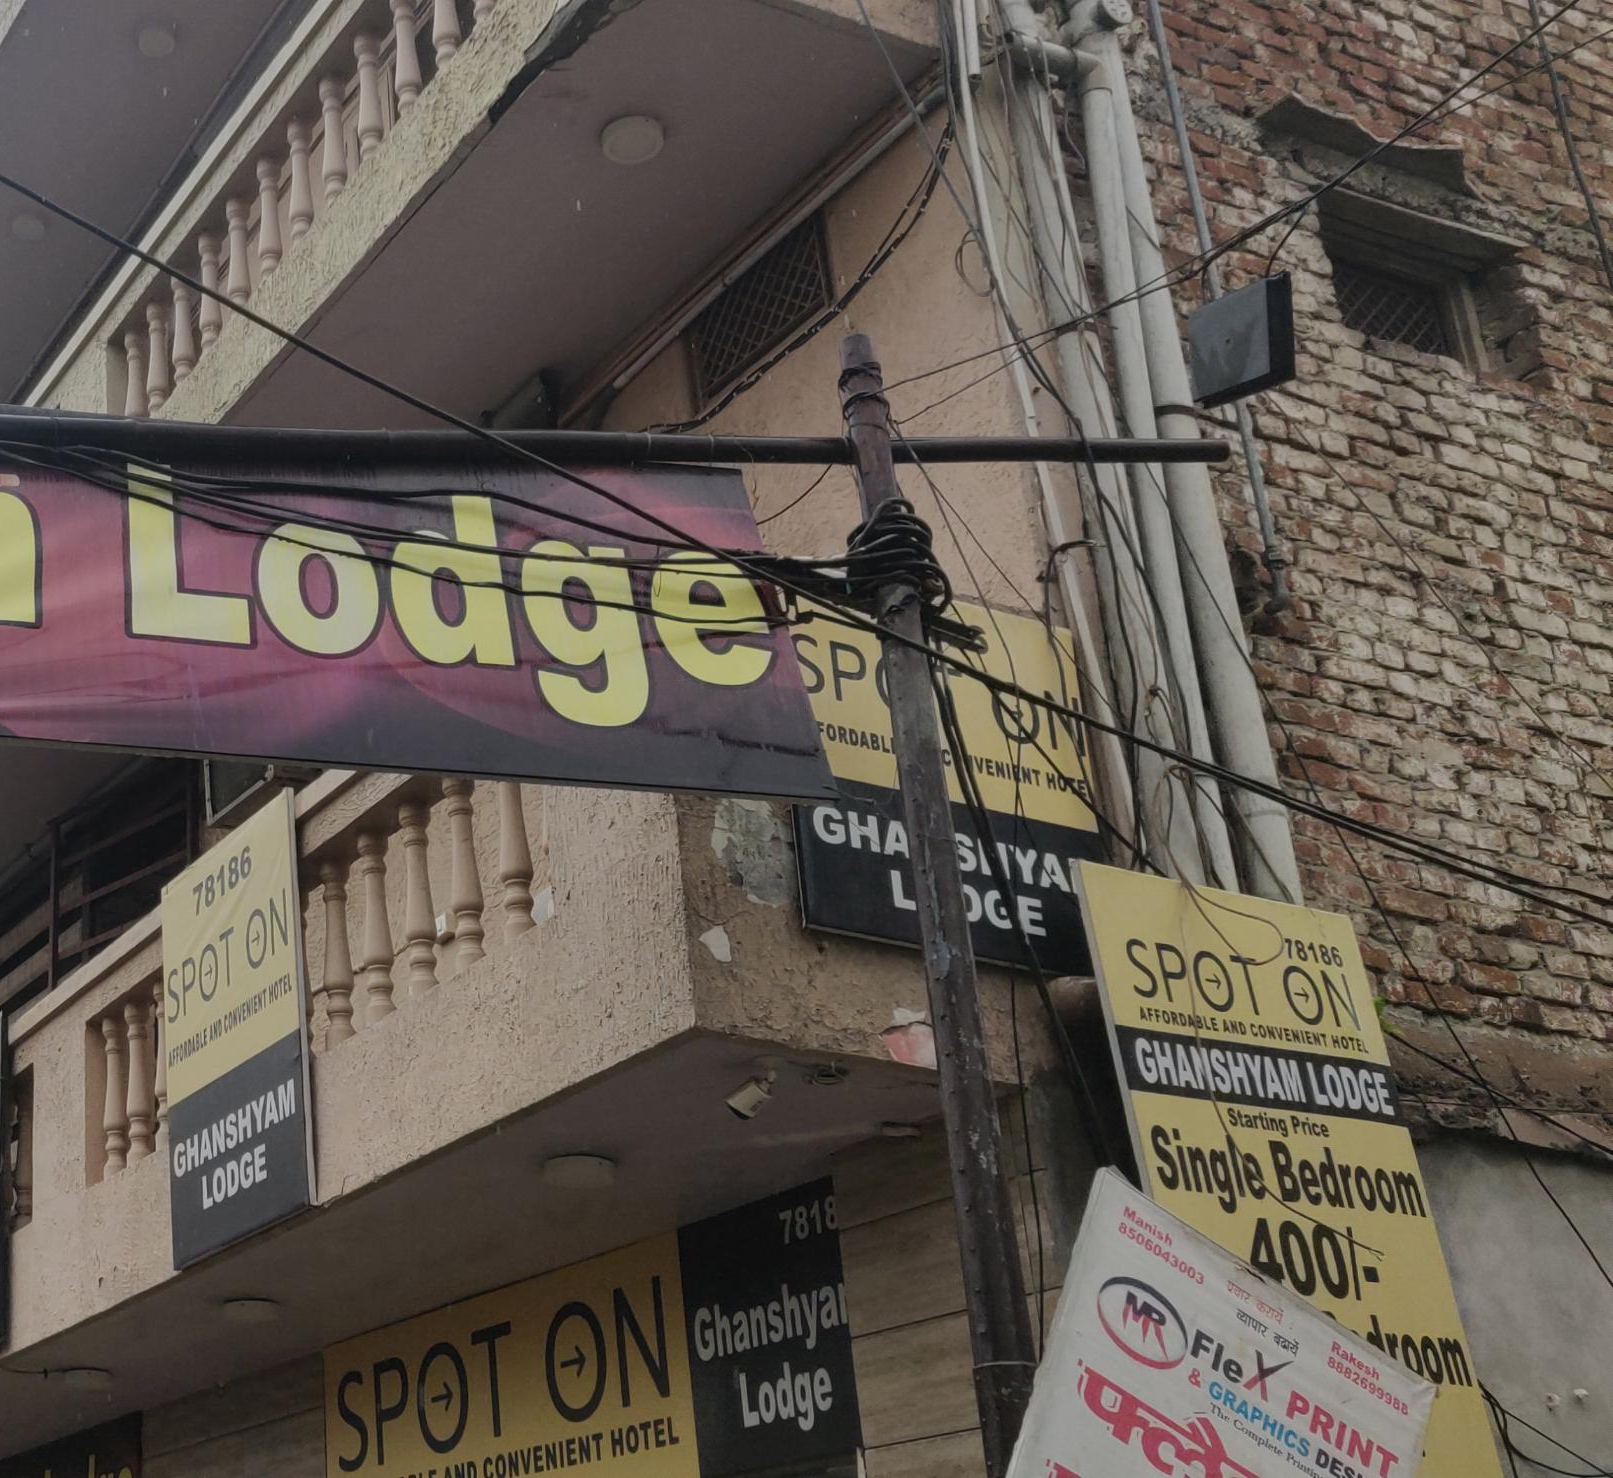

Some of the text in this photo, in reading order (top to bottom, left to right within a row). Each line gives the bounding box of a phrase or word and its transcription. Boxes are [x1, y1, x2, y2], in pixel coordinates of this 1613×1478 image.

[125, 463, 774, 727] Lodge
[790, 633, 1087, 757] SP ON
[192, 845, 253, 917] 78186
[812, 805, 1079, 895] GHASHYA
[890, 869, 1048, 938] LDGE
[166, 887, 289, 1024] SPOT ON
[1126, 937, 1362, 1031] SPOT ON
[1284, 938, 1344, 968] 78186
[168, 972, 292, 1069] AFFORDABLE AND CONVENIENT HOTEL
[1139, 1005, 1369, 1055] AFFORDABLE AND CONVENIENT HOTEL
[1134, 1036, 1396, 1117] GHANSHYAM LODGE
[172, 1079, 296, 1178] GHANSHYAM
[1227, 1108, 1330, 1138] Starting Price
[200, 1143, 268, 1211] LODGE
[1150, 1125, 1427, 1218] Single Bedroom
[1118, 1221, 1206, 1286] 8506043003
[1123, 1205, 1173, 1247] Manish
[1250, 1217, 1380, 1301] 400/-
[337, 1275, 671, 1473] SPOT ON
[1322, 1310, 1473, 1388] droom
[1330, 1340, 1380, 1381] Rakesh
[739, 1360, 833, 1432] Lodge
[1187, 1367, 1364, 1478] & GRAPHICS DES
[1285, 1389, 1400, 1478] PRINT
[483, 1431, 604, 1478] CONVENIENT
[611, 1416, 680, 1457] HOTEL
[1210, 1402, 1328, 1478] The Complete Printin
